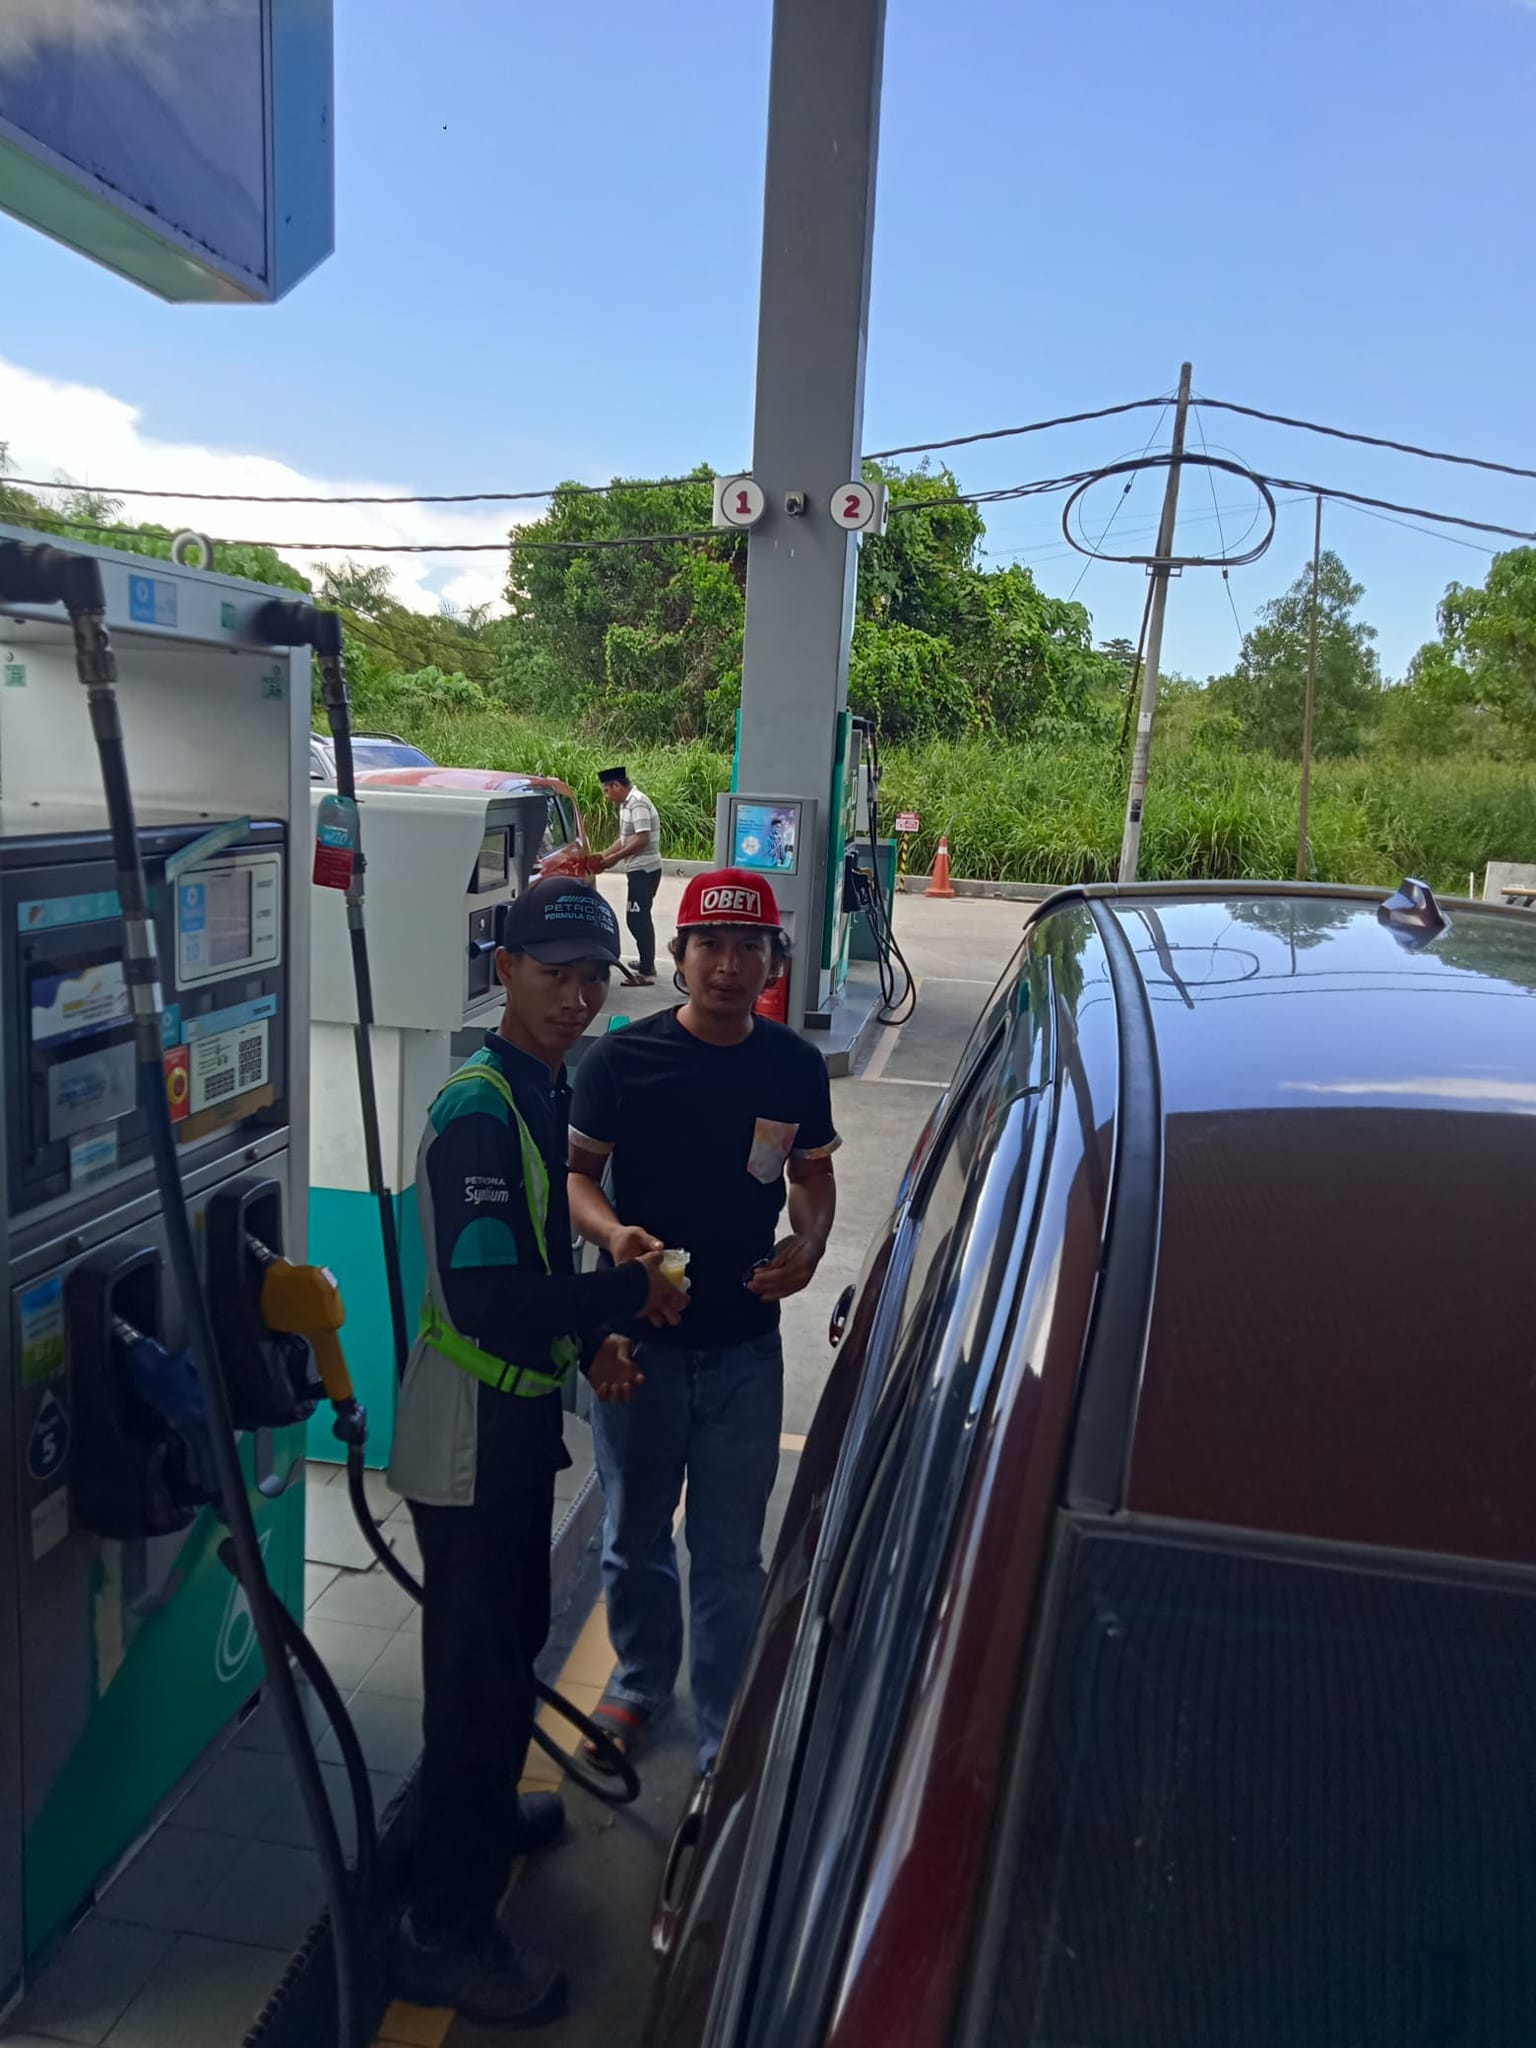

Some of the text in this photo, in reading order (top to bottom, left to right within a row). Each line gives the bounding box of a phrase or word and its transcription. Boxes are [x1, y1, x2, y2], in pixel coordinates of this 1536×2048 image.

[736, 491, 751, 514] 1
[843, 495, 861, 518] 2
[704, 890, 756, 911] OBEY
[545, 904, 614, 927] PETROAS
[465, 1176, 508, 1186] PETRONA
[465, 1186, 509, 1204] Syium
